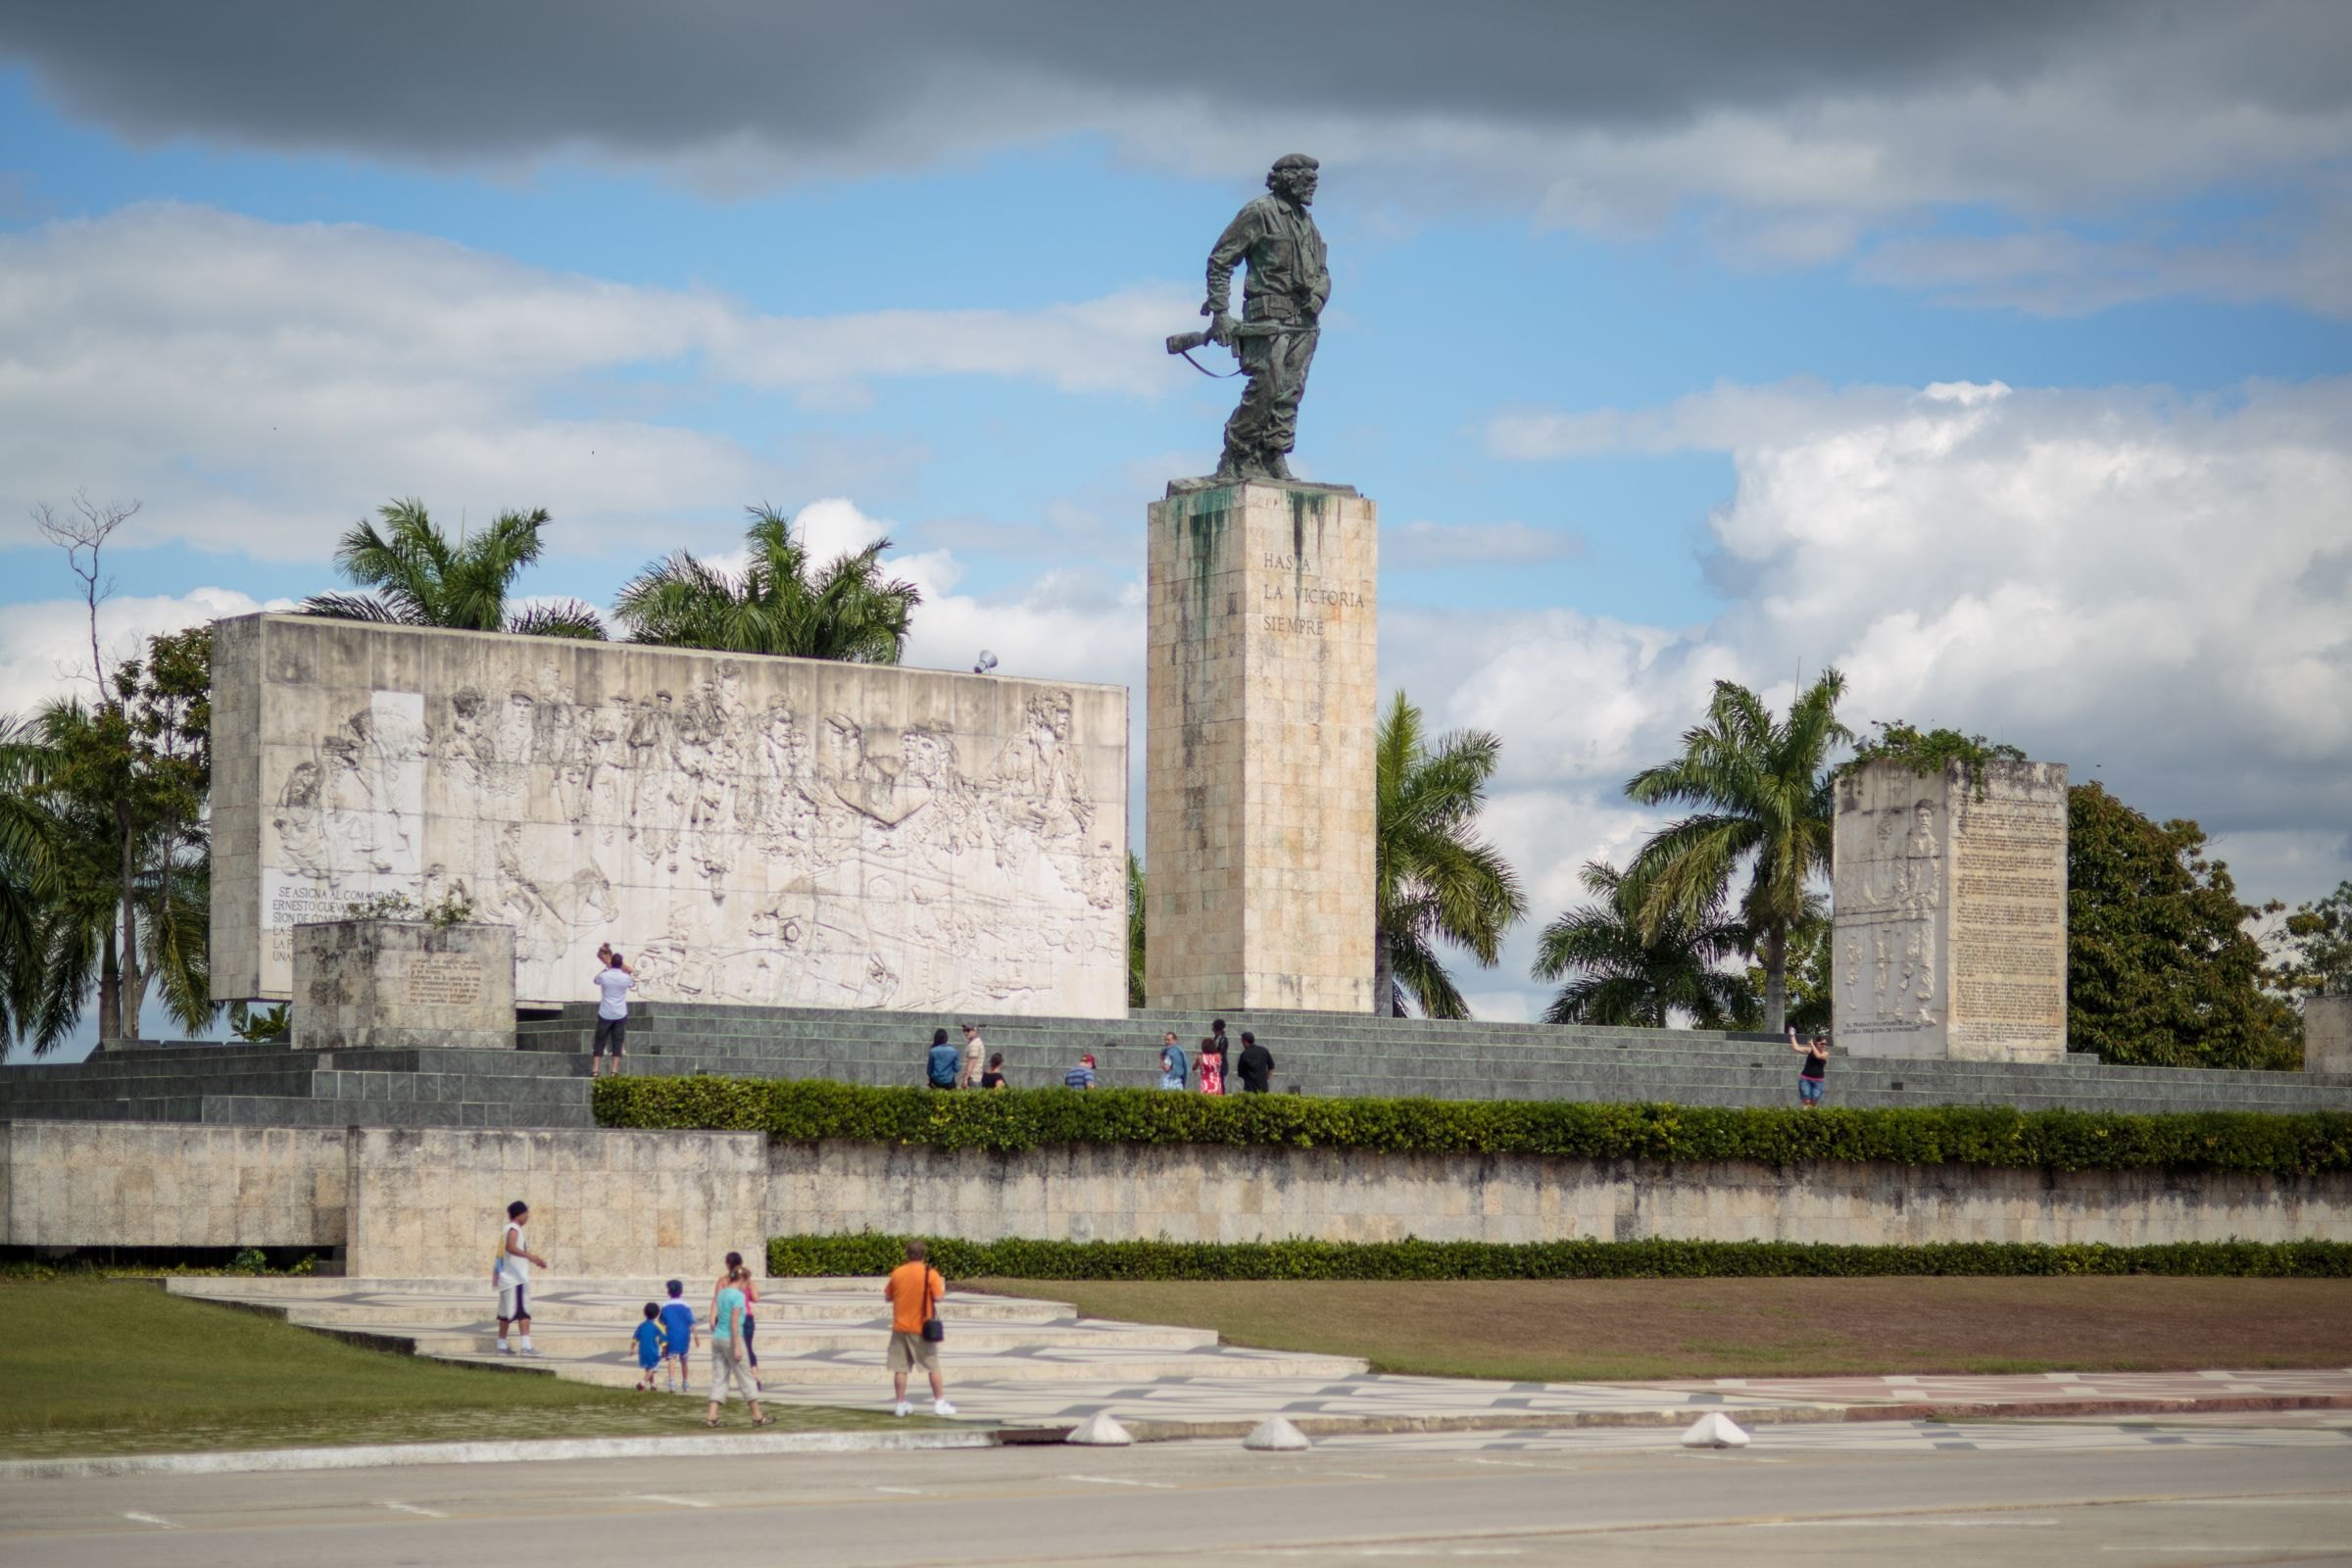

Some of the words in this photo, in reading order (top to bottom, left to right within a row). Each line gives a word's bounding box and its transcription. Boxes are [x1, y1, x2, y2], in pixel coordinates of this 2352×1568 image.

[1264, 553, 1310, 571] HASTA
[1264, 584, 1283, 600] LA
[1294, 588, 1364, 608] VICTORIA
[1263, 615, 1324, 635] SIEMPRE
[278, 887, 291, 898] SE
[330, 889, 342, 900] AL
[272, 900, 315, 911] ERNESTO
[272, 912, 294, 923] SION
[273, 925, 285, 936] LA
[273, 938, 285, 950] LA
